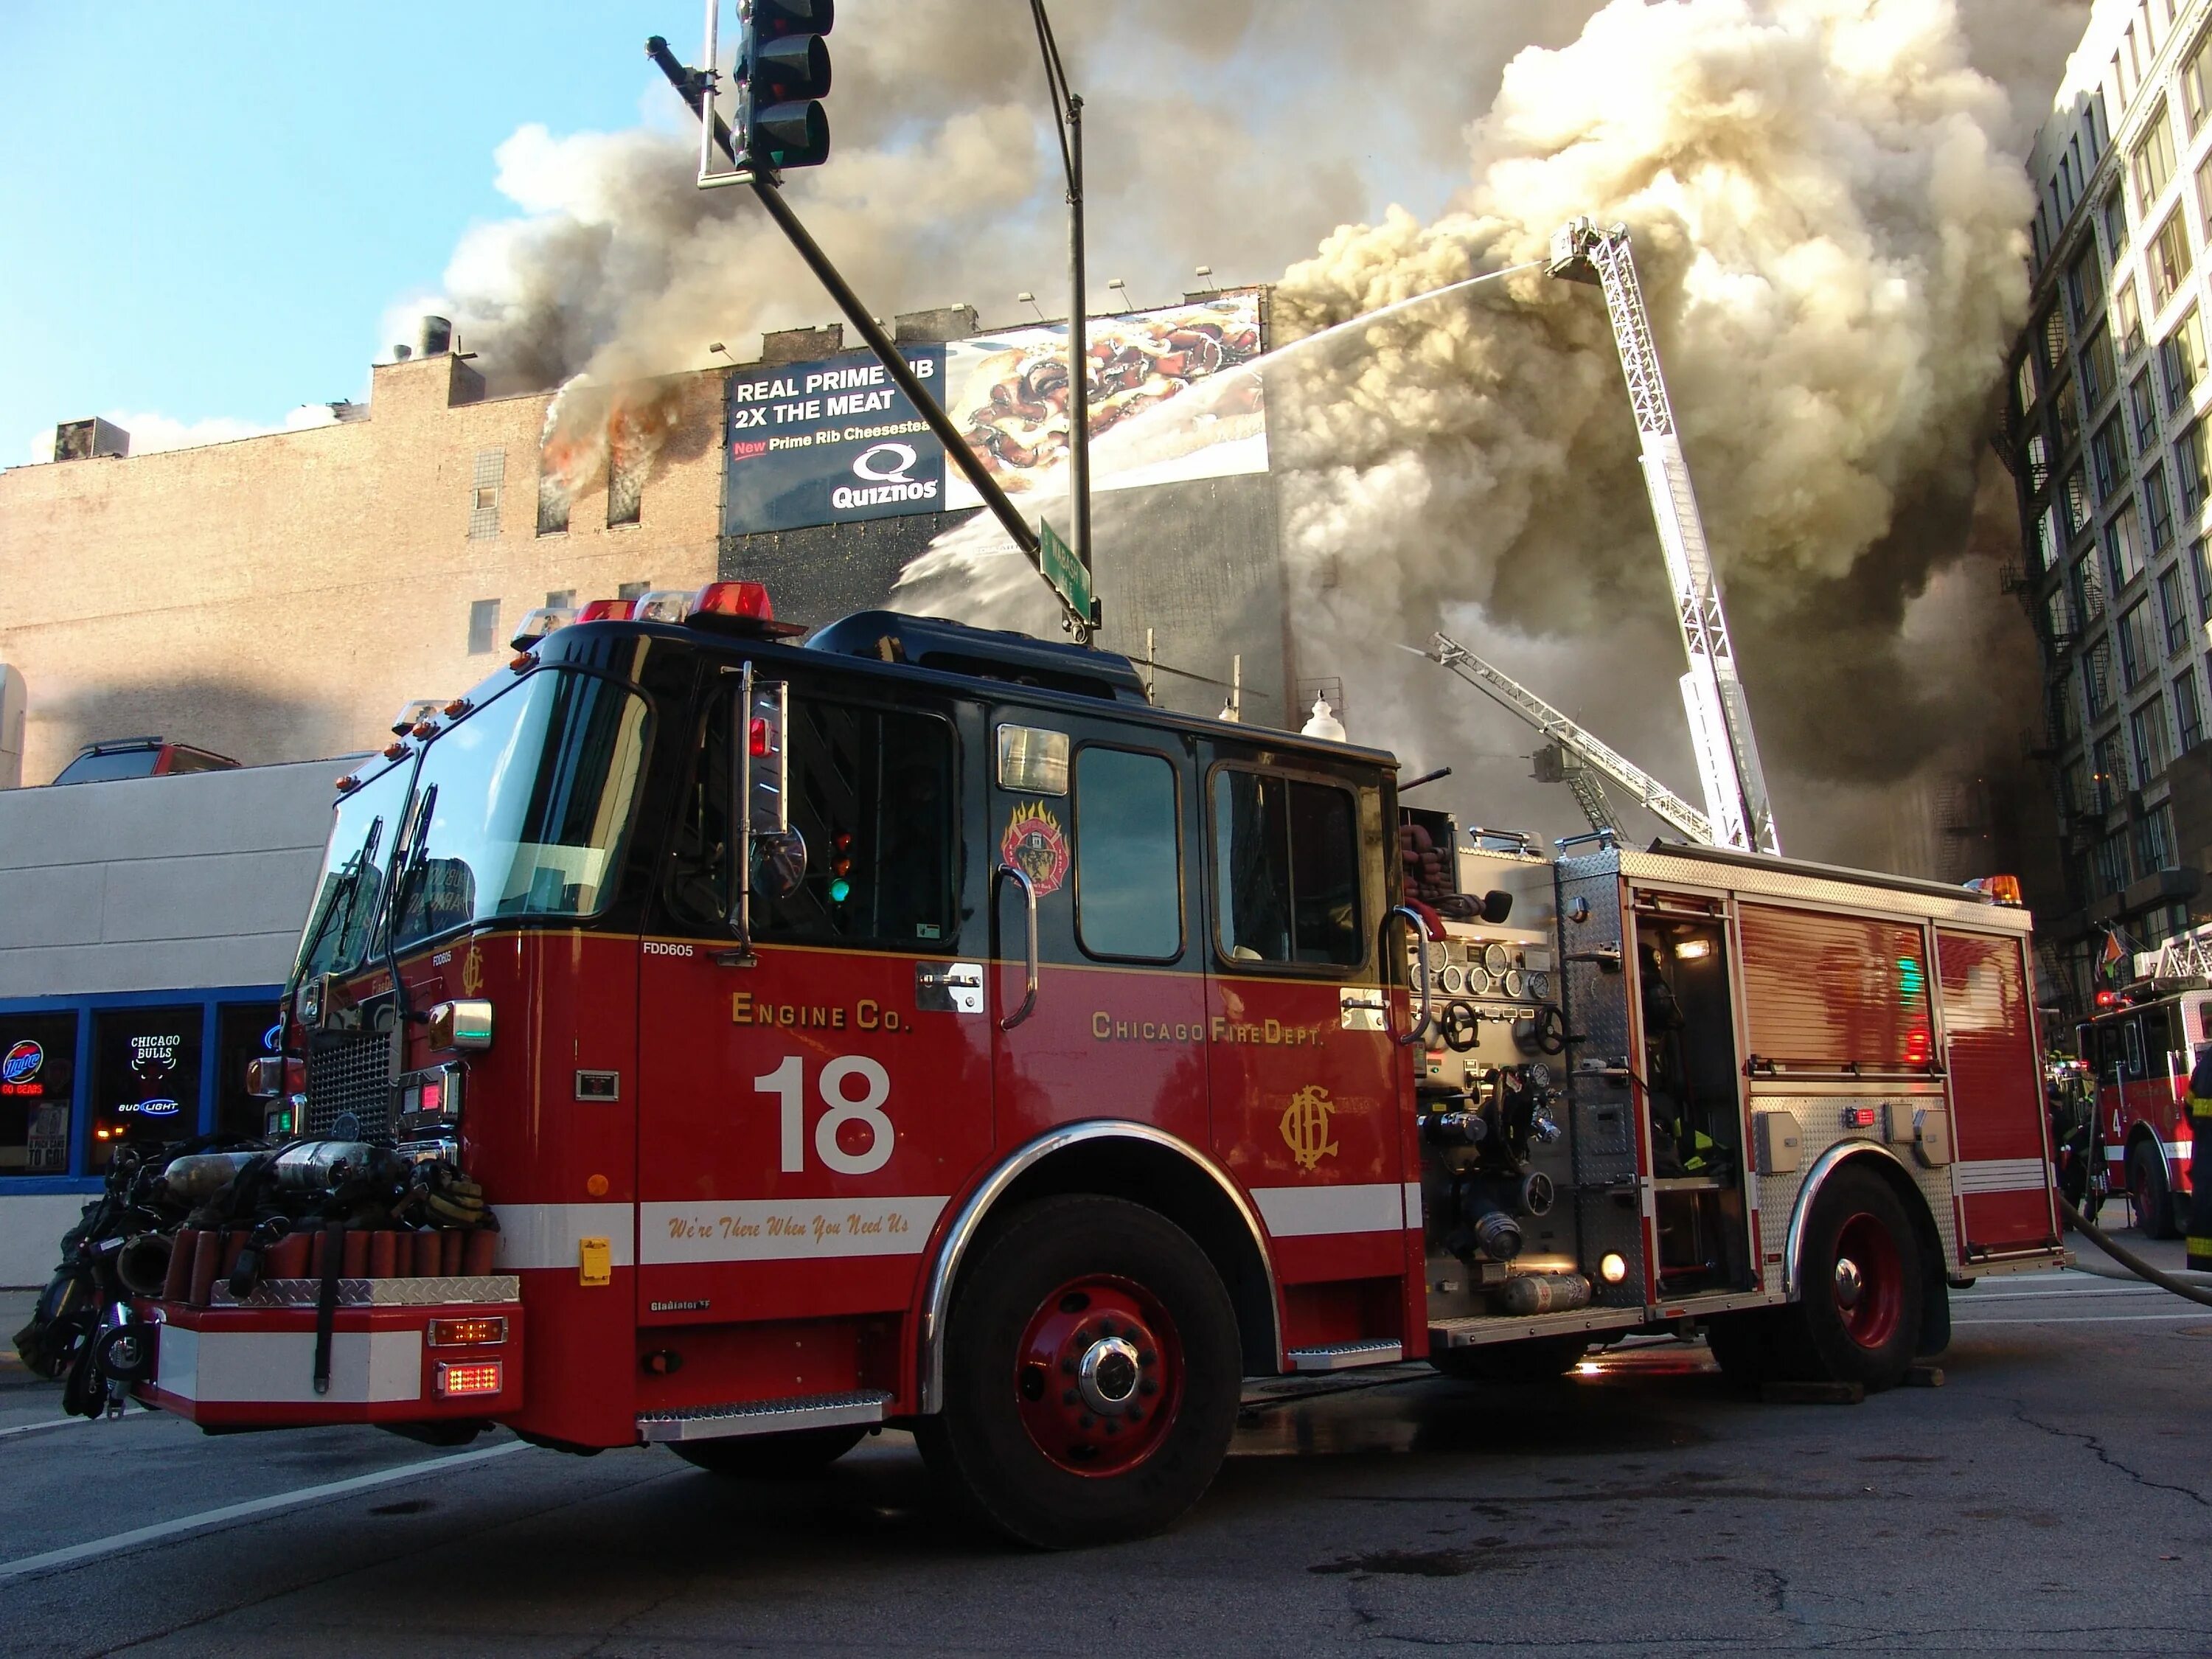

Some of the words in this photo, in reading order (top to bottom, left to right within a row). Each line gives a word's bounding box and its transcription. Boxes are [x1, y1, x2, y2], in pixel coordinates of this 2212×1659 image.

[737, 378, 799, 403] REAL
[805, 365, 885, 394] PRIME
[891, 359, 934, 383] IB
[734, 407, 768, 428] 2X
[773, 400, 821, 424] THE
[827, 389, 895, 417] MEAT
[734, 441, 766, 454] New
[769, 435, 813, 451] Prime
[815, 430, 841, 444] Rib
[1051, 537, 1079, 583] WABASH
[643, 942, 693, 957] FDD605
[131, 1034, 180, 1047] CHICAGO
[137, 1047, 173, 1059] BULLS
[118, 1104, 140, 1112] BUD
[145, 1102, 179, 1111] LIGHT
[754, 1054, 895, 1175] 18
[2112, 1108, 2121, 1138] 4
[29, 1149, 42, 1166] TO
[668, 1217, 713, 1239] We're
[718, 1216, 760, 1239] There
[766, 1216, 807, 1237] When
[812, 1214, 841, 1245] You
[846, 1213, 883, 1236] Need
[887, 1212, 909, 1234] Us
[651, 1300, 698, 1311] Gladiator
